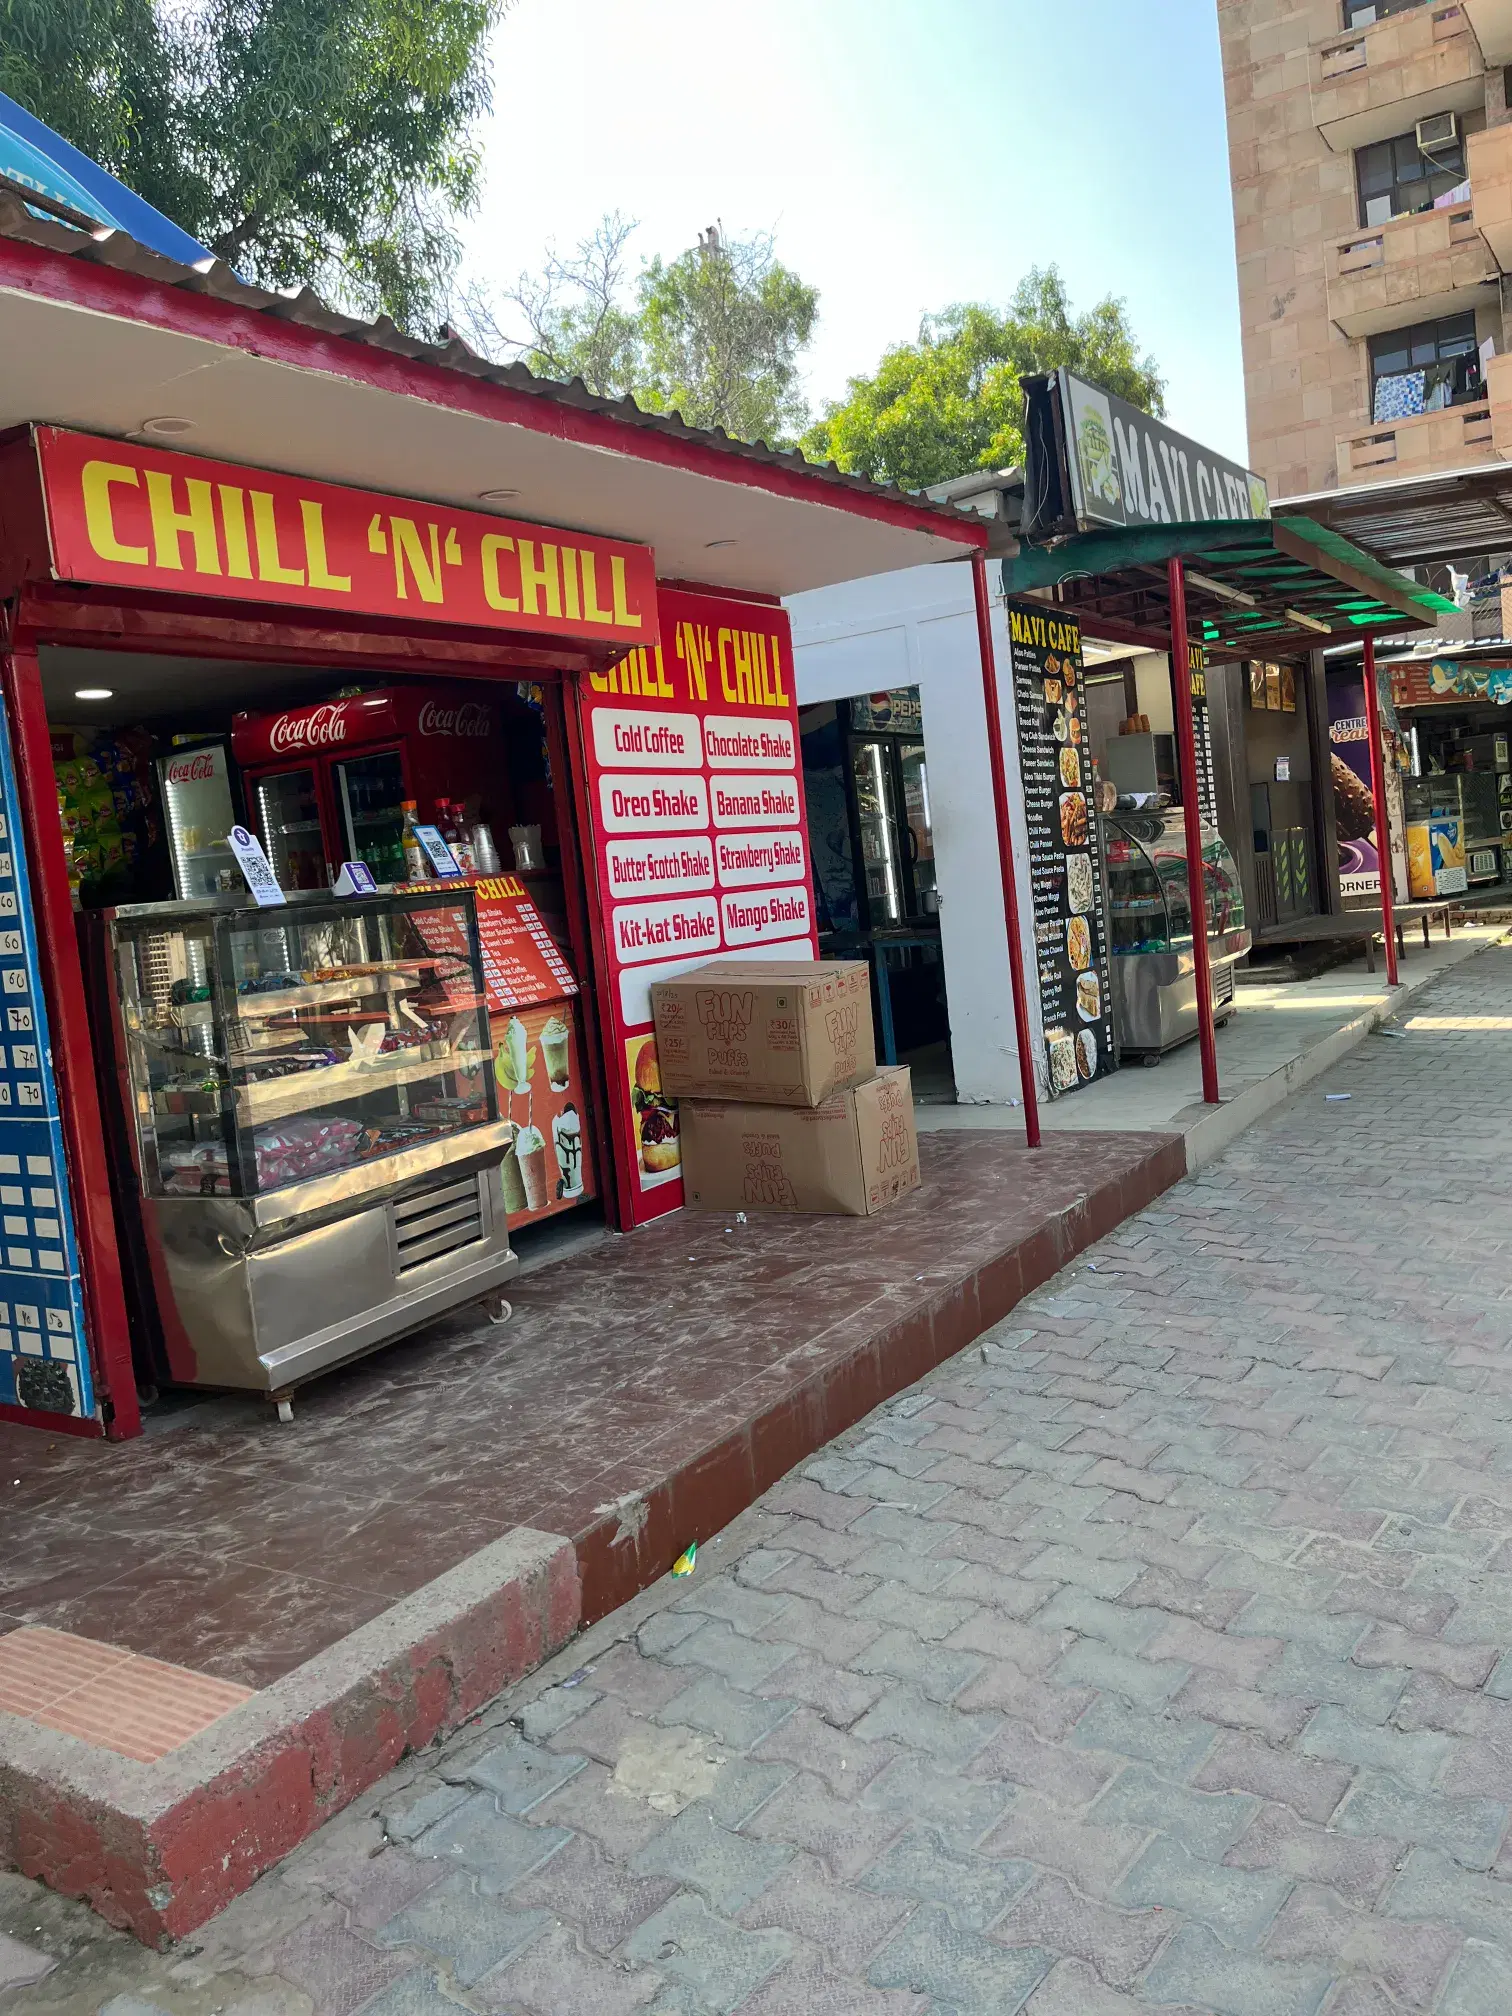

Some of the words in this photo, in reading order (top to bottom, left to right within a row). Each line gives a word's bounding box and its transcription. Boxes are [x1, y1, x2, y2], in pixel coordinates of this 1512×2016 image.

[1113, 416, 1195, 523] MAVI
[1196, 459, 1249, 521] CAFE
[81, 460, 351, 592] CHILL
[368, 513, 463, 604] 'N'
[480, 533, 642, 628] CHILL
[1010, 611, 1046, 648] MAVI
[1048, 620, 1080, 654] CAFE
[676, 621, 713, 701] 'N'
[718, 628, 790, 707] CHILL
[1188, 646, 1203, 671] AVI
[1016, 675, 1032, 685] Samosa
[1191, 673, 1206, 696] AFE
[893, 699, 921, 718] PEPS
[1018, 703, 1030, 712] Bread
[269, 702, 350, 753] Coca-Cola
[1020, 717, 1031, 726] Bread
[1335, 717, 1367, 731] CENTRE
[614, 724, 643, 752] Cold
[644, 725, 684, 754] Coffee
[706, 731, 760, 758] Chocolate
[761, 733, 792, 758] Shake
[1329, 727, 1369, 743] reat
[1036, 745, 1054, 754] Sandwich
[1022, 758, 1037, 767] Paneer
[1037, 758, 1055, 767] Sandwich
[1043, 772, 1056, 782] Burger
[1025, 786, 1038, 795] Paneer
[1038, 786, 1052, 795] Burger
[612, 789, 650, 817] Oreo
[652, 789, 699, 816] Shake
[716, 791, 761, 816] Banana
[762, 790, 795, 815] Shake
[1040, 800, 1053, 809] Burger
[612, 855, 647, 883] Butter
[647, 852, 681, 881] Scotch
[681, 850, 710, 877] Shake
[720, 844, 774, 873] Strawberry
[774, 840, 801, 866] Shake
[1041, 853, 1053, 861] Sauce
[1041, 866, 1053, 874] Sauce
[1053, 865, 1065, 873] Pasta
[475, 876, 525, 900] CHILL
[1340, 879, 1381, 893] ORNER
[726, 903, 769, 931] Mango
[769, 896, 805, 922] Shake
[619, 917, 673, 948] Kit-kat
[673, 912, 715, 941] Shake
[9, 972, 25, 989] 60
[695, 989, 754, 1026] FUN
[10, 1009, 30, 1031] 70
[706, 1021, 747, 1042] FLIPS
[825, 1001, 858, 1043] FUN
[833, 1031, 857, 1056] FLIPS
[706, 1047, 749, 1067] PUFFS
[835, 1055, 857, 1078] PUFFS
[24, 1085, 39, 1104] 70
[877, 1089, 904, 1114] PUFFS
[881, 1114, 905, 1140] FLIPS
[742, 1141, 781, 1159] PUFFS
[879, 1128, 911, 1174] FUN
[744, 1163, 783, 1181] FLIPS
[743, 1176, 799, 1207] FUN
